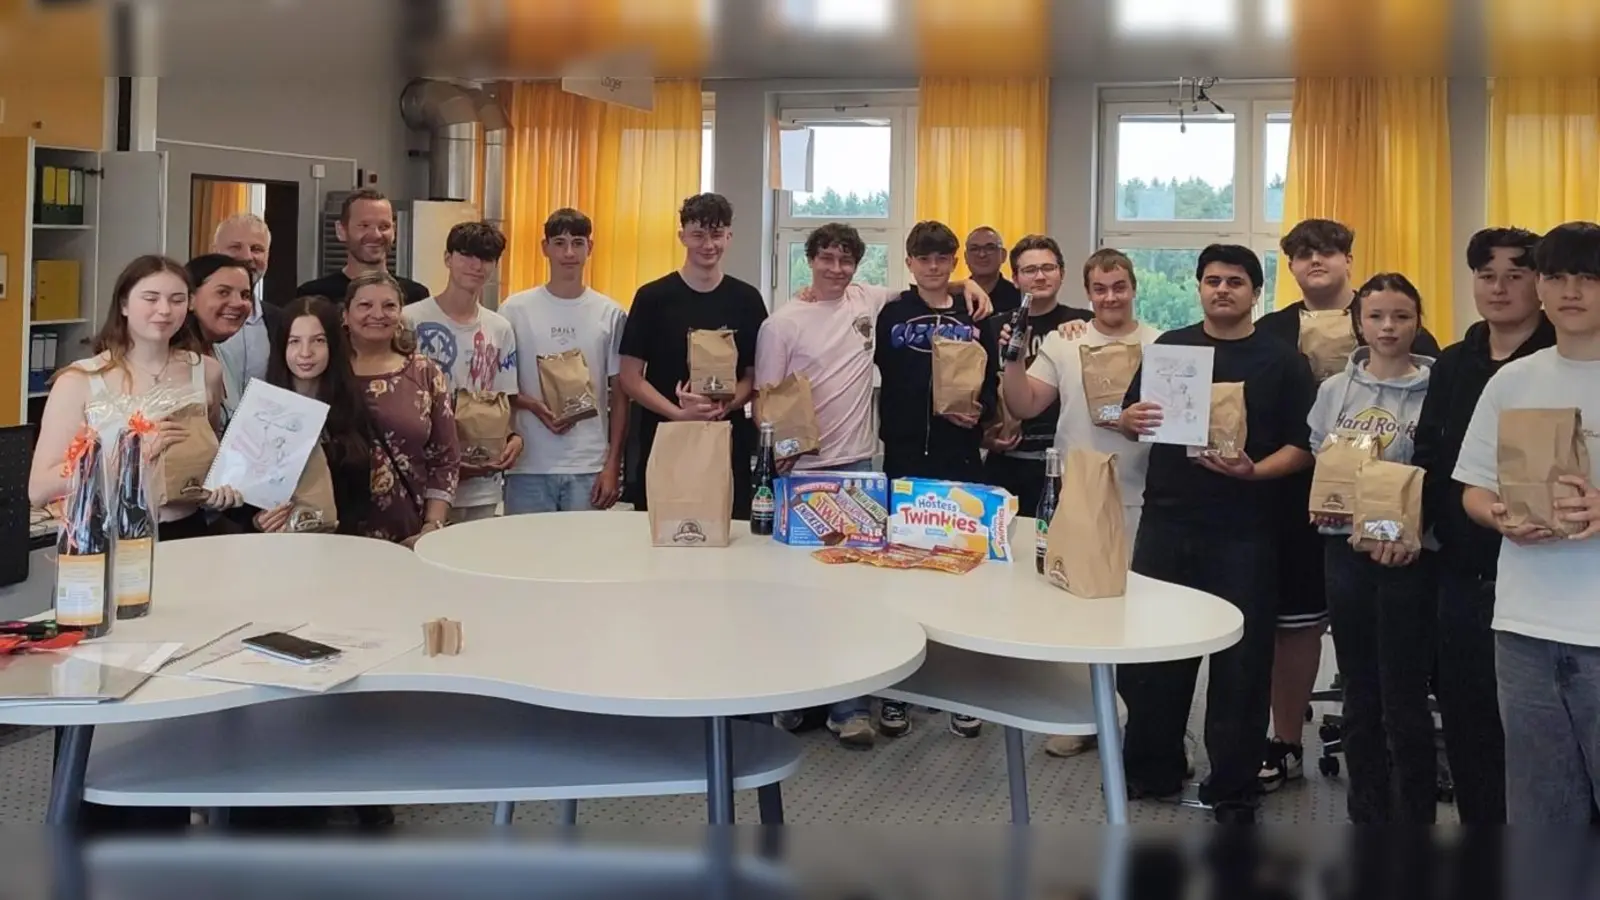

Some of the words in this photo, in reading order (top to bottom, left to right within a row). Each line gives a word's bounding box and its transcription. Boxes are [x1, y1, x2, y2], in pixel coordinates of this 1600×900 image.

[1336, 412, 1374, 431] Hard
[918, 498, 957, 513] Hostess
[797, 504, 830, 537] SNICKERS
[900, 507, 977, 534] Twinkies
